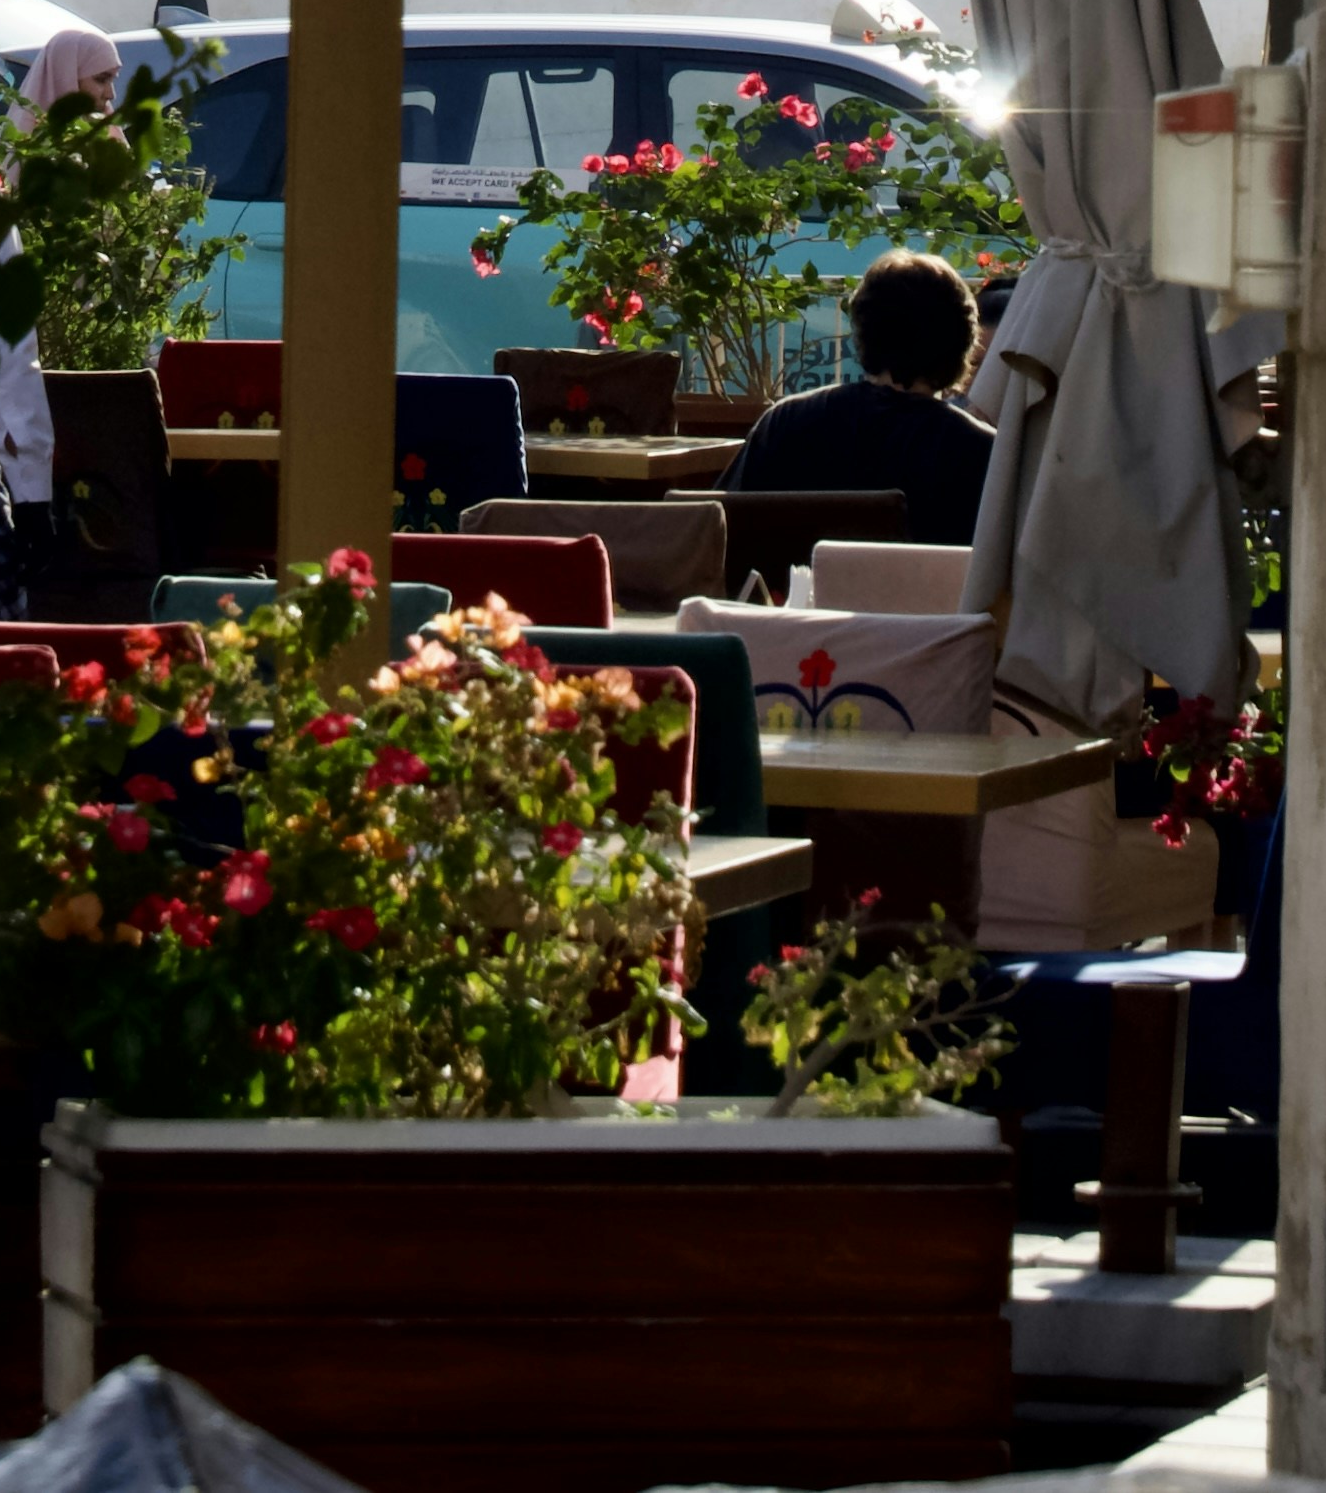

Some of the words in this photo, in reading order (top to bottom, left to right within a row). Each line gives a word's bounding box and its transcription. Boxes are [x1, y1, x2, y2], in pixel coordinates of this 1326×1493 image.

[431, 177, 446, 186] WE
[448, 178, 482, 187] ACCEPT
[484, 180, 509, 188] CARD
